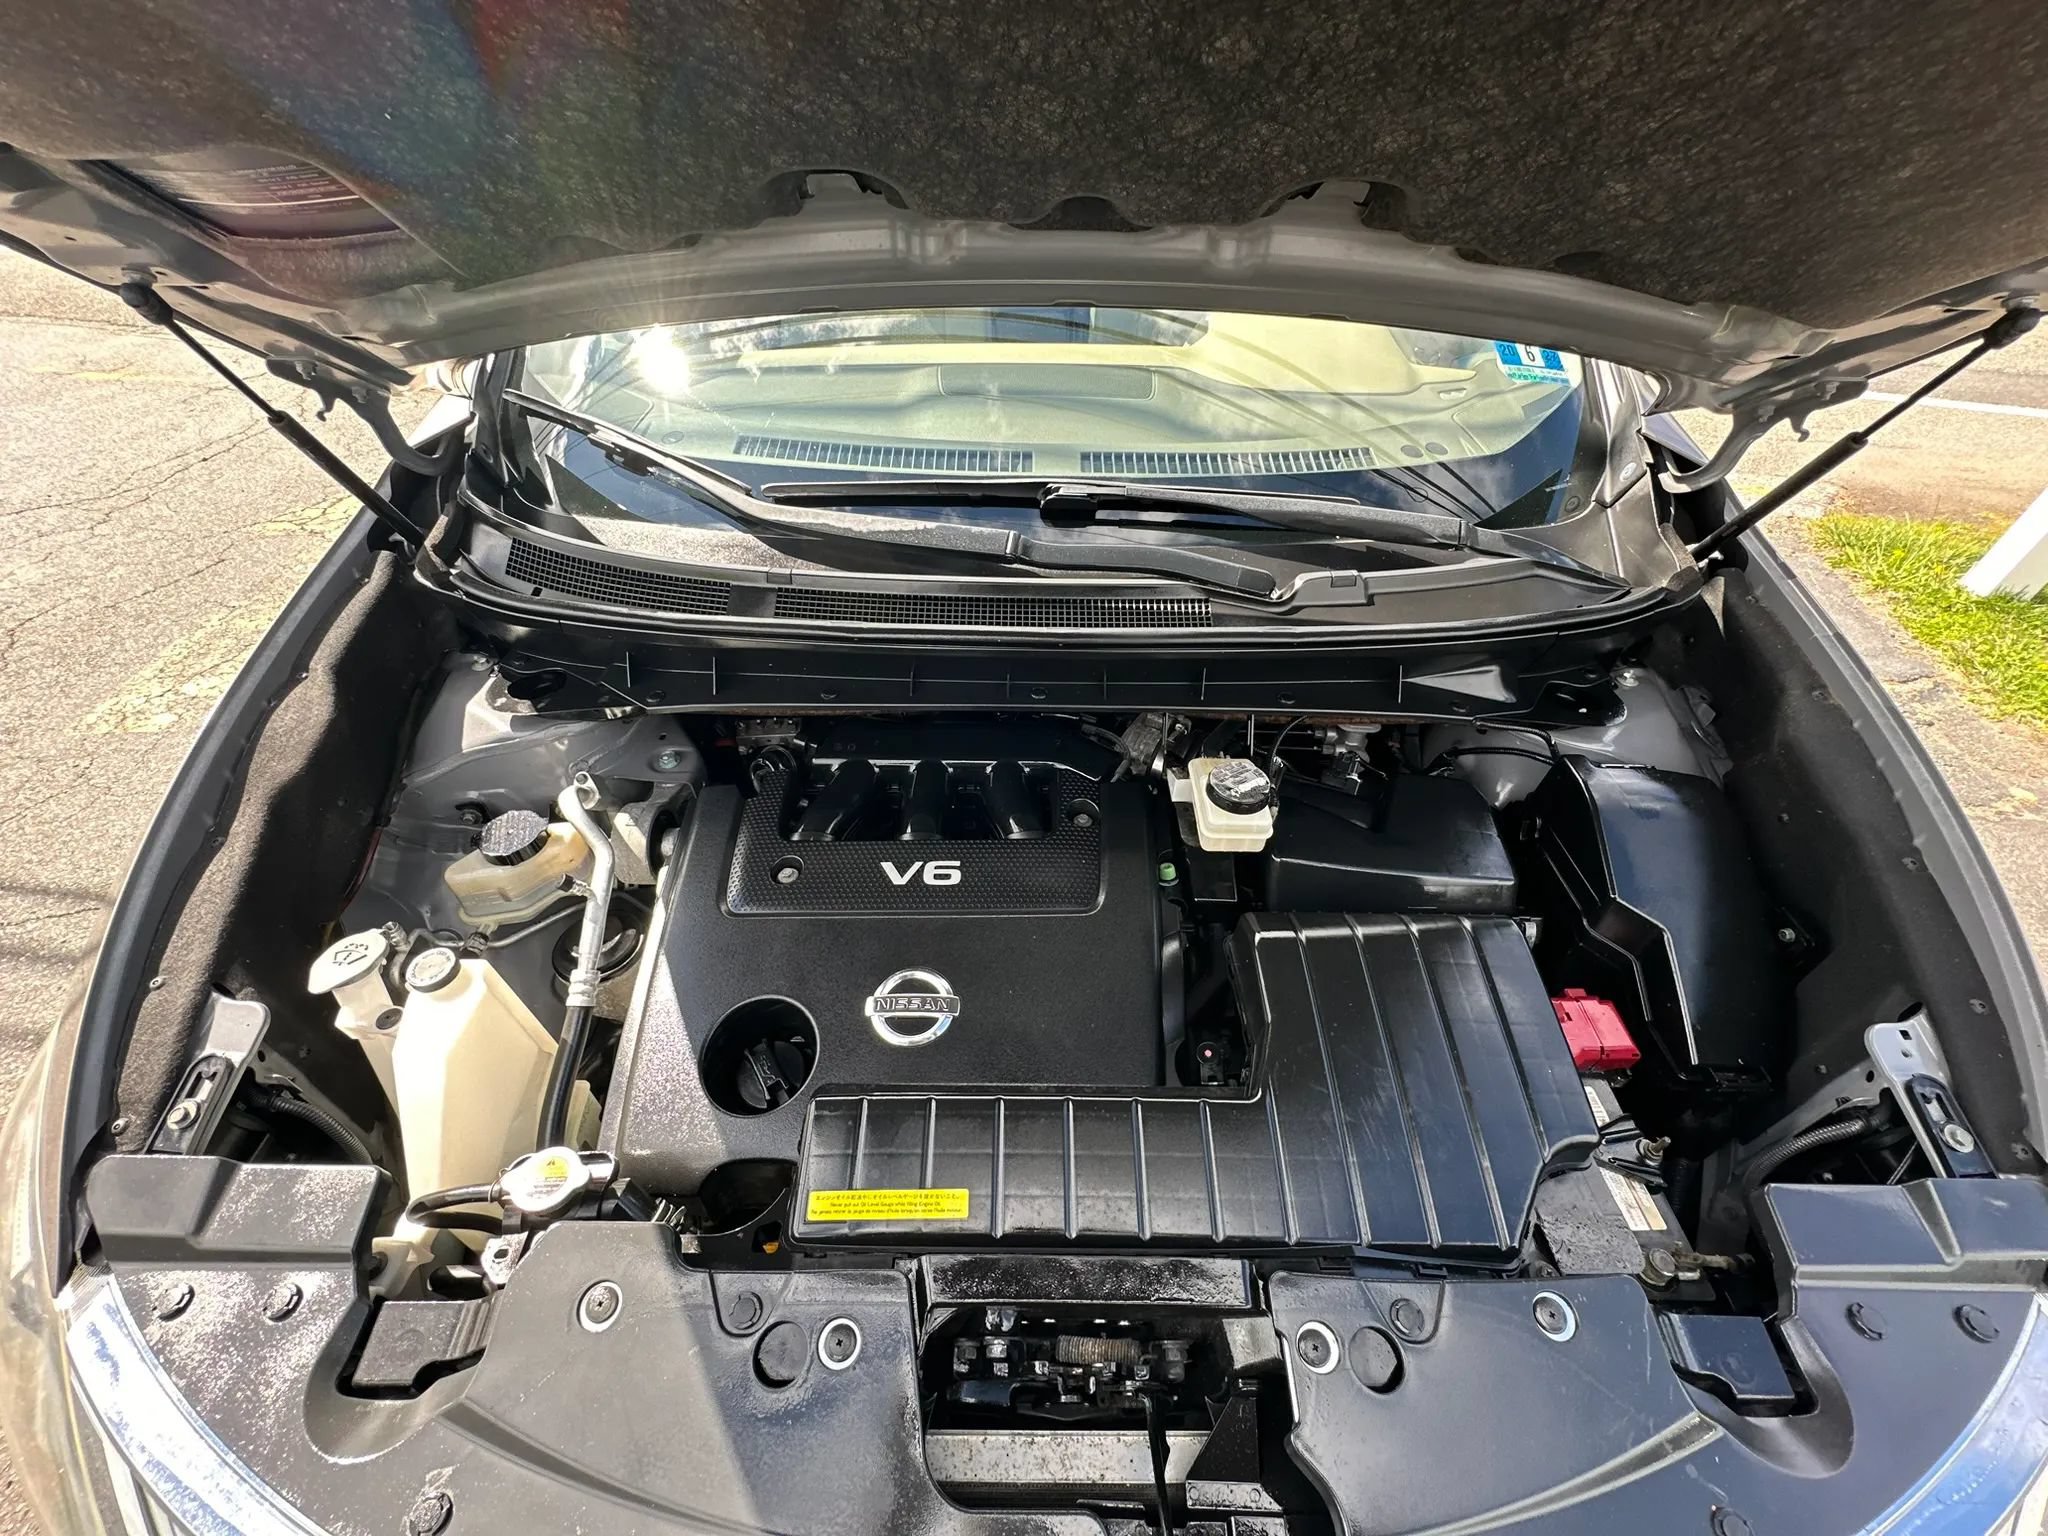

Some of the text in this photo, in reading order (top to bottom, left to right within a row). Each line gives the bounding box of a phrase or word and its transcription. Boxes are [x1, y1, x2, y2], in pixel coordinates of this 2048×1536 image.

[1499, 344, 1516, 357] 20
[1524, 345, 1536, 362] 6
[880, 861, 962, 886] V6
[875, 998, 950, 1012] NISSAN
